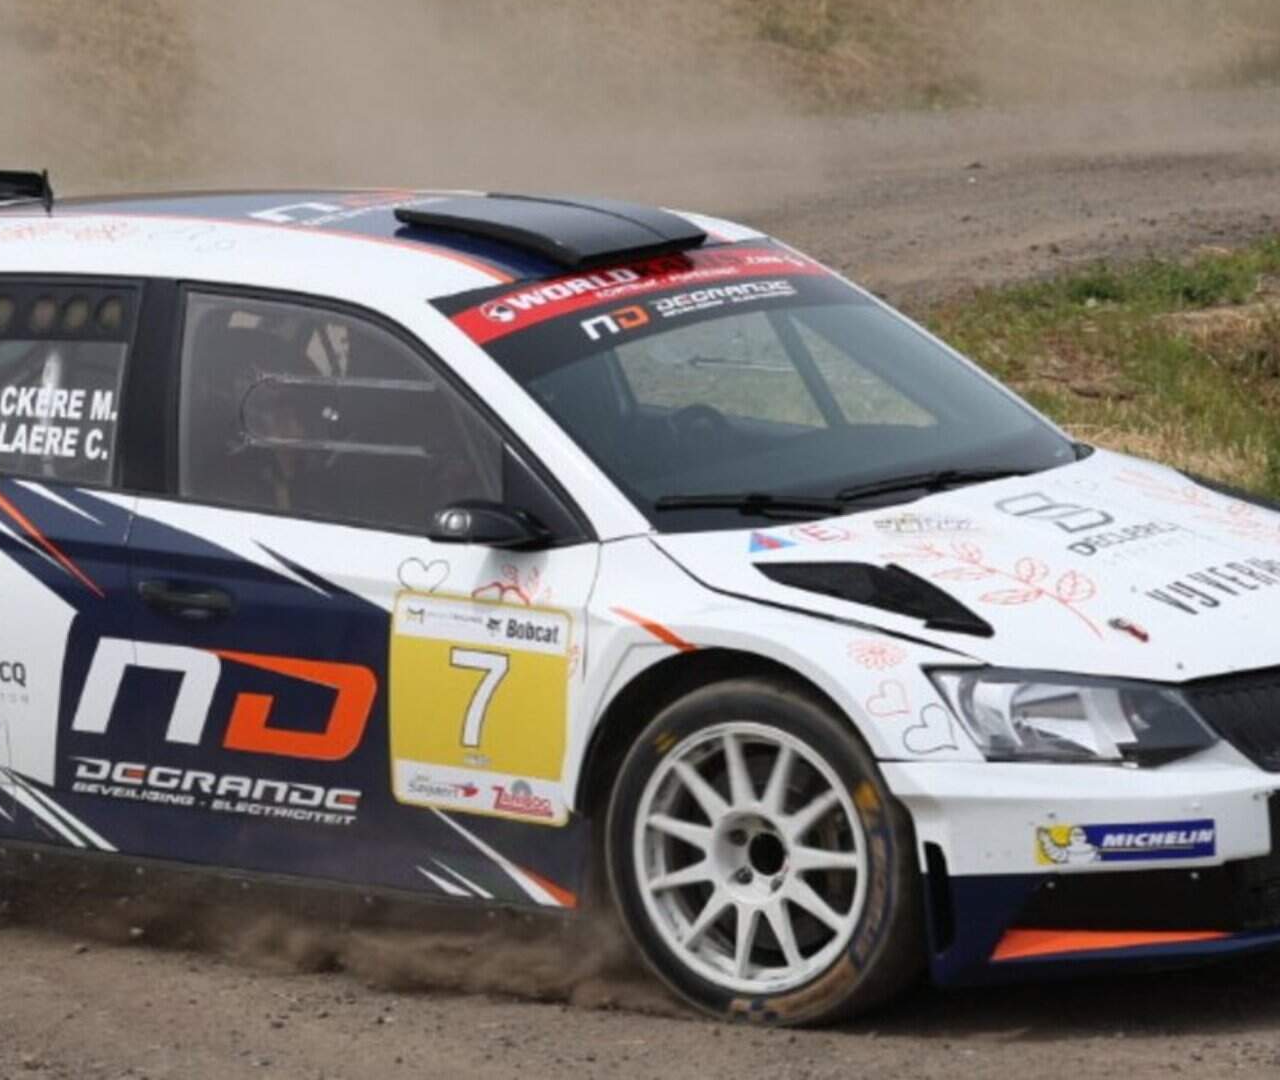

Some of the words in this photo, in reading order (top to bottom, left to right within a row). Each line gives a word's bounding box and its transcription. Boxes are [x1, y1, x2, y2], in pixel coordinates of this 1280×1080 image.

[508, 267, 640, 310] WORLD
[89, 389, 119, 422] M.
[84, 428, 109, 461] C.
[506, 618, 560, 644] Bobcat
[449, 646, 510, 748] 7
[70, 756, 363, 812] DEGRANDE
[1102, 827, 1213, 850] MICHELIN
